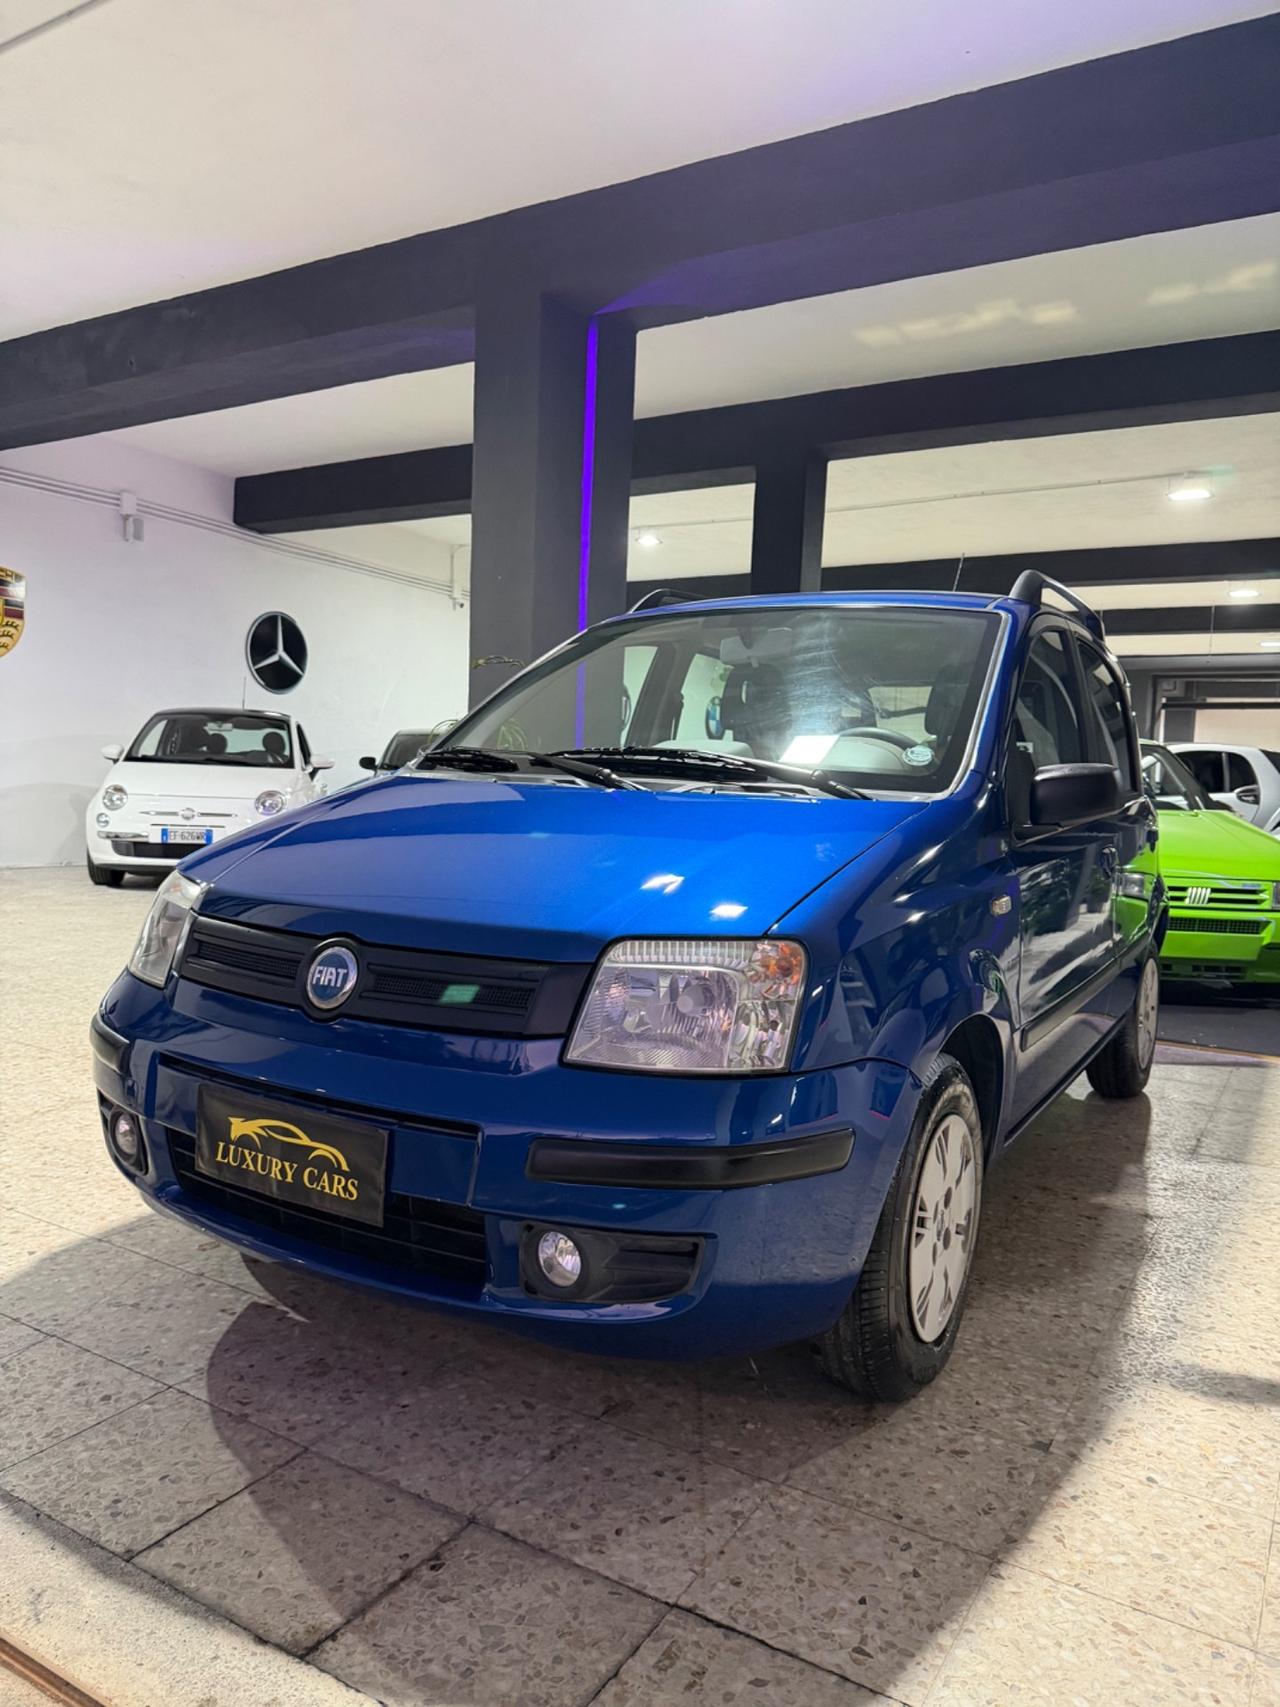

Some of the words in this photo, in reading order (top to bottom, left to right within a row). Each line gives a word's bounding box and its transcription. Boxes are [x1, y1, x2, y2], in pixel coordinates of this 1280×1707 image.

[312, 966, 348, 988] FIAT
[215, 1141, 298, 1183] LUXURY
[303, 1167, 359, 1201] CARS
